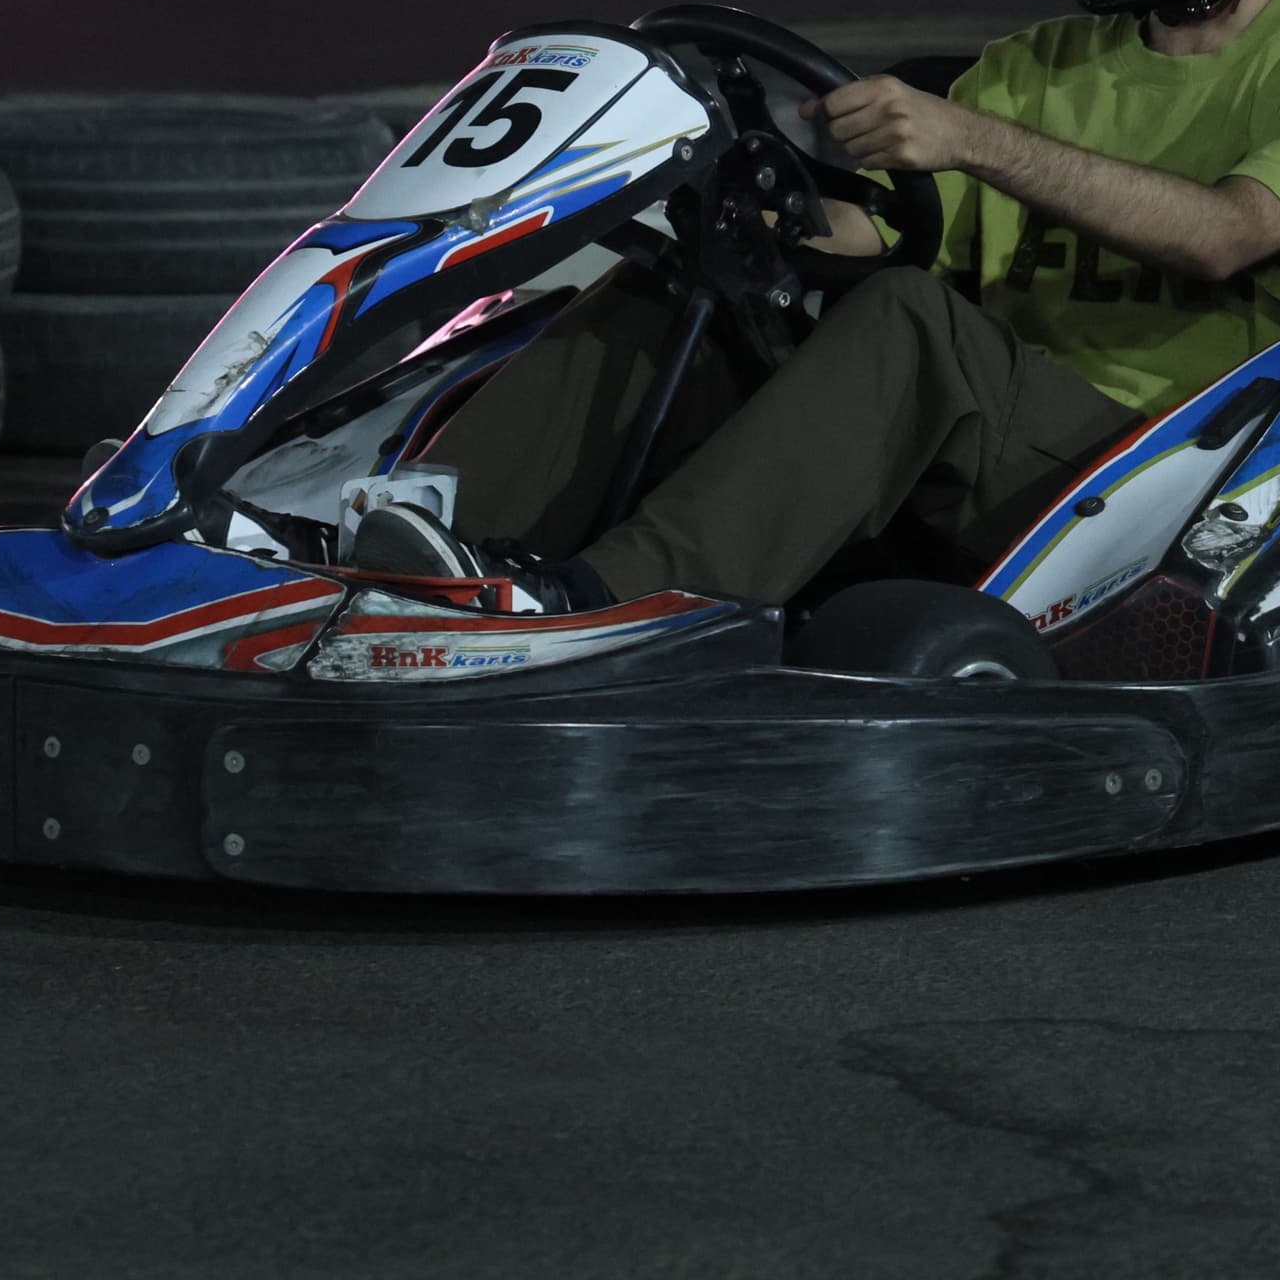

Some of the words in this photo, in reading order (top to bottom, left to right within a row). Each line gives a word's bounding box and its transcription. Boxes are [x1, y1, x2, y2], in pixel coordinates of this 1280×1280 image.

[400, 68, 580, 169] 15
[370, 646, 448, 668] KnK
[450, 652, 528, 667] karts
